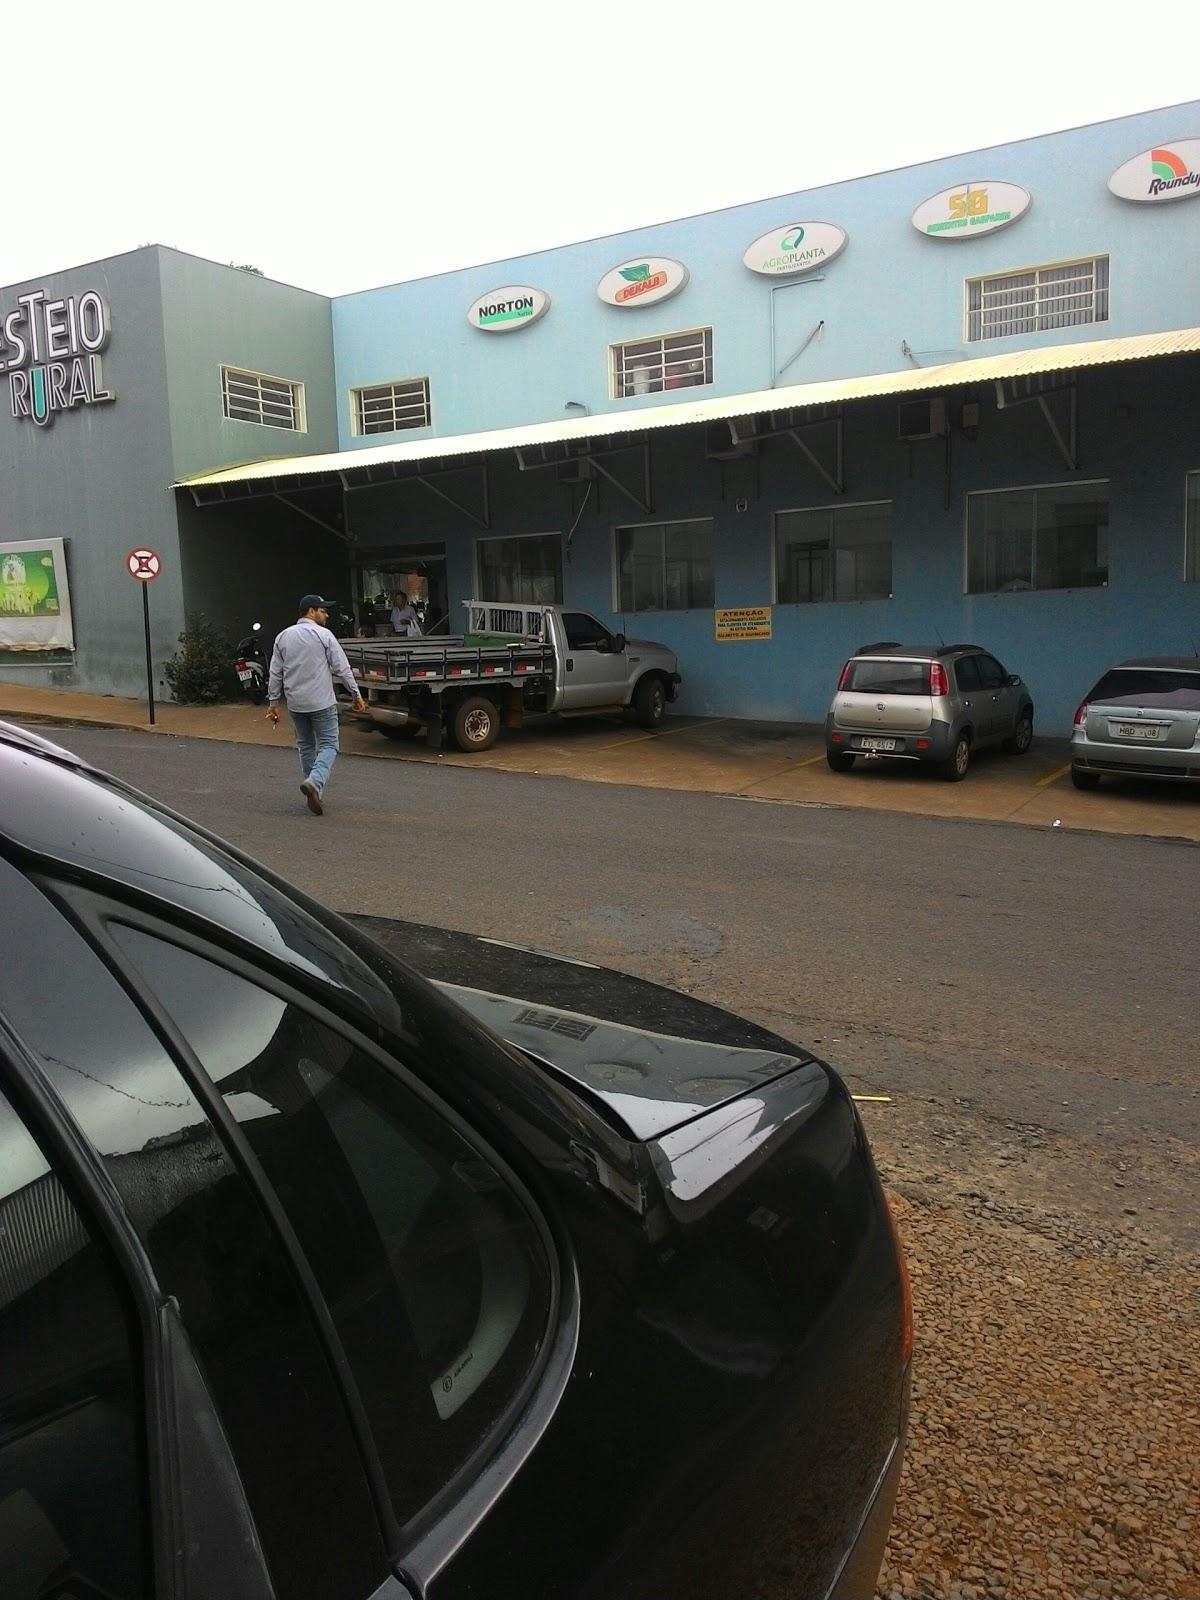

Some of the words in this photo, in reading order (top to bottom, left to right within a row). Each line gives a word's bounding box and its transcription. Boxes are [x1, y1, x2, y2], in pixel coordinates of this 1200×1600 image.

[762, 248, 826, 270] AGROPLANTA
[623, 276, 660, 299] DEKALB
[479, 297, 534, 318] NORTON
[0, 289, 105, 369] STEIO
[9, 354, 112, 426] RURAL
[722, 609, 764, 617] ATENÇÃO
